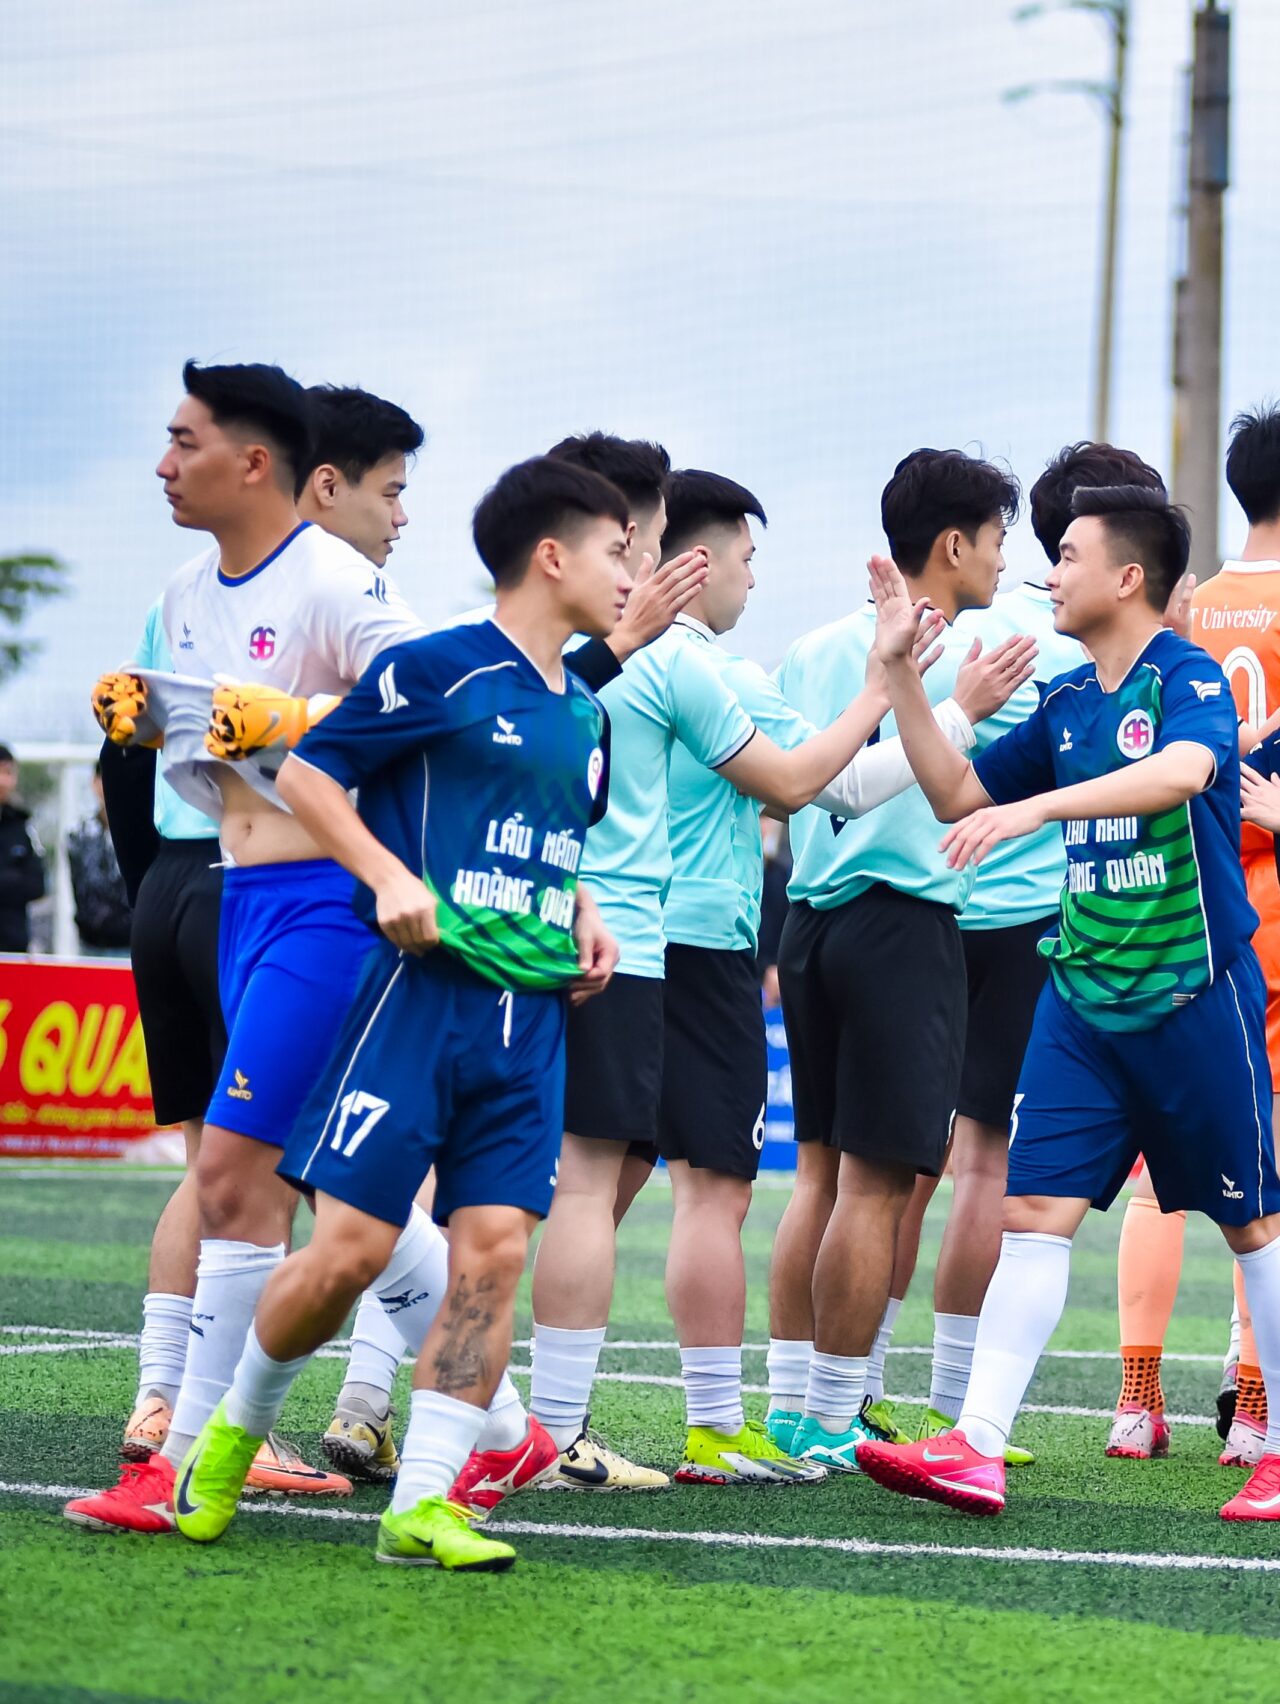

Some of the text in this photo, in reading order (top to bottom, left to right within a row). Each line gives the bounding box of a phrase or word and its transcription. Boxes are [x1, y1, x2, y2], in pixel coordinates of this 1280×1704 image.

[1201, 602, 1278, 633] University
[485, 812, 582, 875] LẨU NẤM
[453, 866, 535, 916] HOÀNG
[1105, 850, 1167, 893] QUÂN
[330, 1089, 391, 1158] 17
